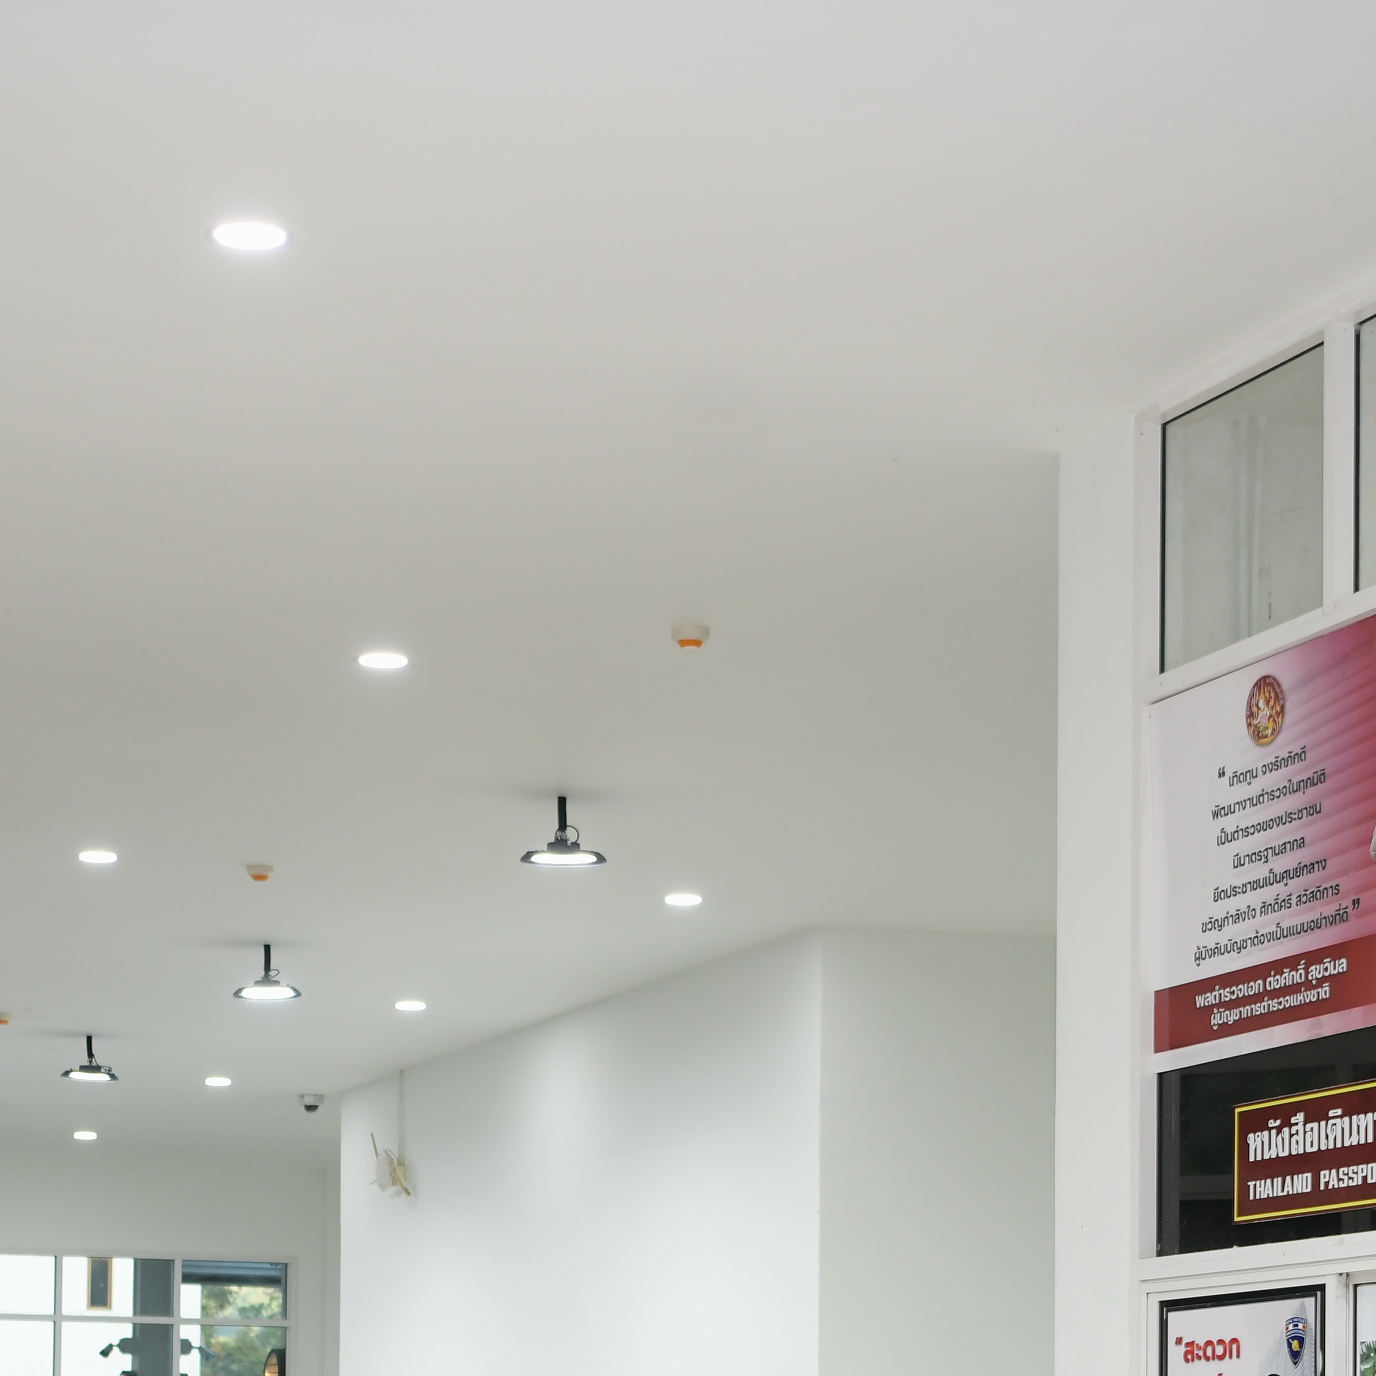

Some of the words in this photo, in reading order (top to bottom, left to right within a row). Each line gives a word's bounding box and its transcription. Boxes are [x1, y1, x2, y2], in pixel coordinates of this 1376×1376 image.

[1261, 745, 1307, 777] จงรักภักดี
[1211, 768, 1326, 821] พัฒนางานตำรวจในทุกมิติ
[1217, 802, 1322, 846] เป็นตำรวจของประชาชน
[1232, 836, 1305, 869] มีมาตรฐานสากล
[1212, 858, 1327, 903] ยึดประชาชนเป็นศูนย์กลาง
[1295, 883, 1340, 907] สวัสดิการ
[1195, 978, 1263, 1008] พลตำรวจเอก
[1266, 960, 1305, 990] ต่อศักดิ์
[1308, 958, 1347, 985] สุขวิมล
[1210, 983, 1331, 1030] ผู้บัญชาการตำรวจแห่งชาติ
[1247, 1172, 1313, 1200] THAILAND
